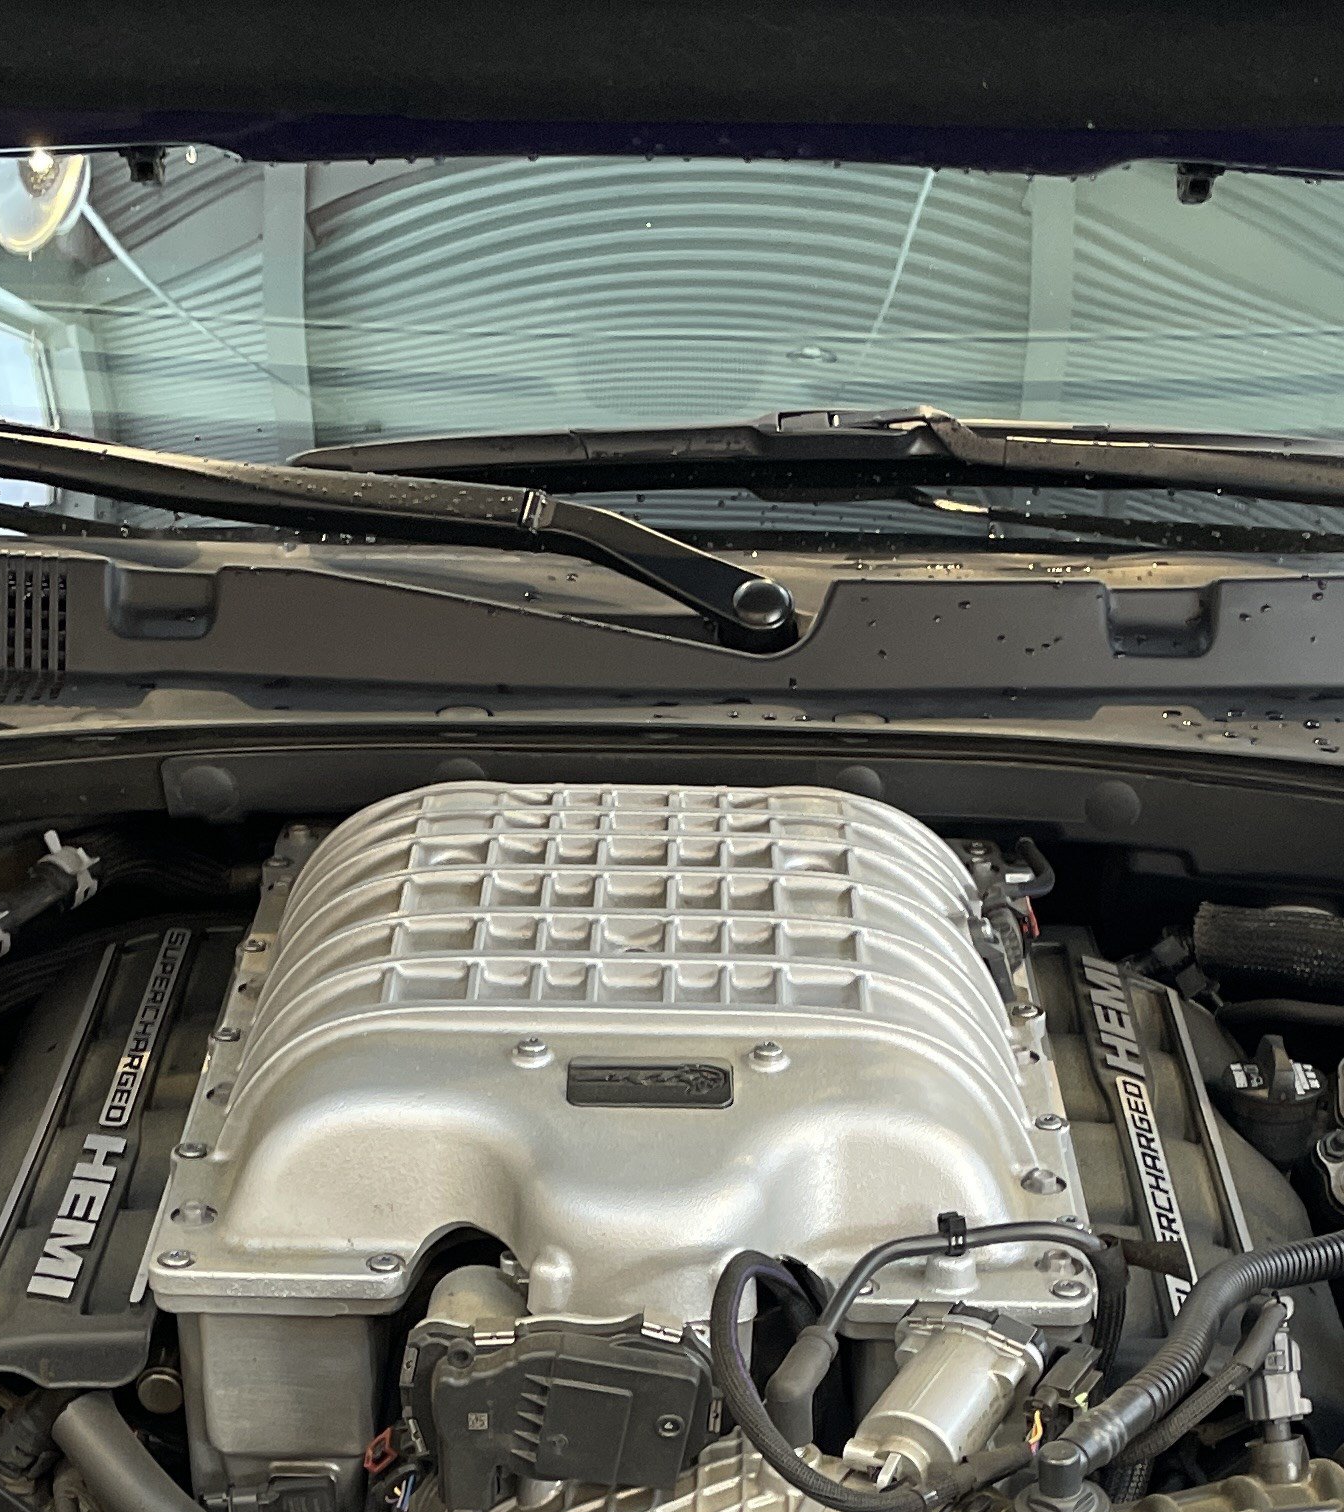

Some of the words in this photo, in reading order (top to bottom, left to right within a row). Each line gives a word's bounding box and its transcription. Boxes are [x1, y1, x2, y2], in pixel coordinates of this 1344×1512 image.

[103, 931, 188, 1124] SUPERCHARGED
[1081, 955, 1146, 1078] HEMI
[26, 1134, 126, 1299] HEMI
